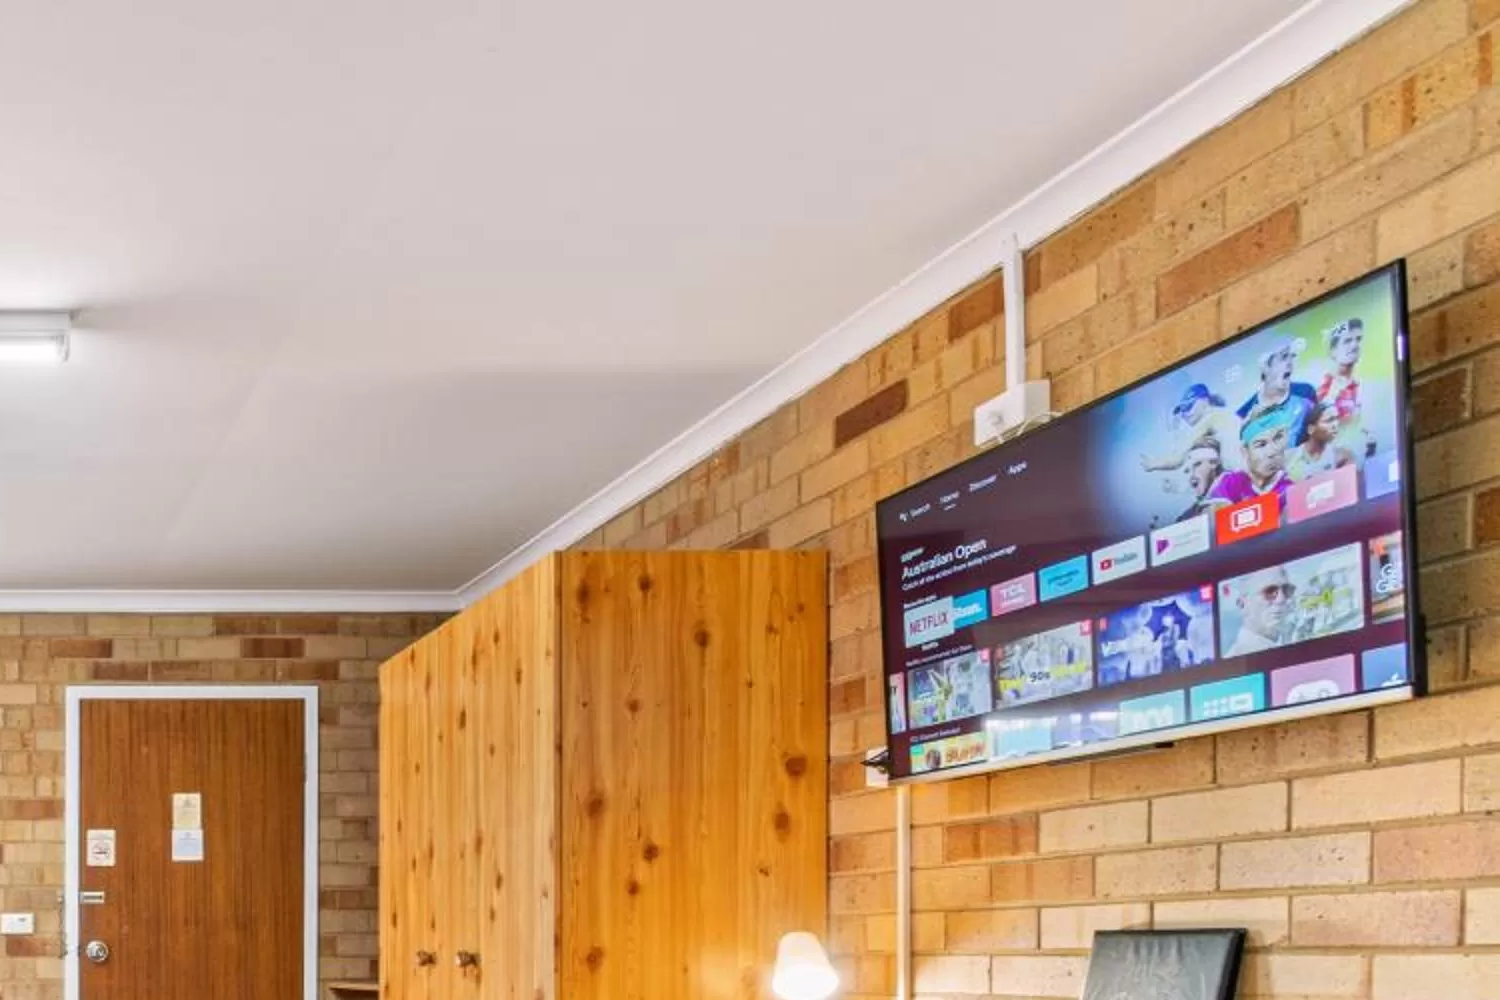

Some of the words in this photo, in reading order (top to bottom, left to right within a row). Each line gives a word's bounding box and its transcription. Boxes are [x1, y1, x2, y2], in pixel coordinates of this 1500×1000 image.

[901, 552, 954, 581] Australian
[954, 538, 988, 560] Open
[909, 611, 949, 637] NETFLIX
